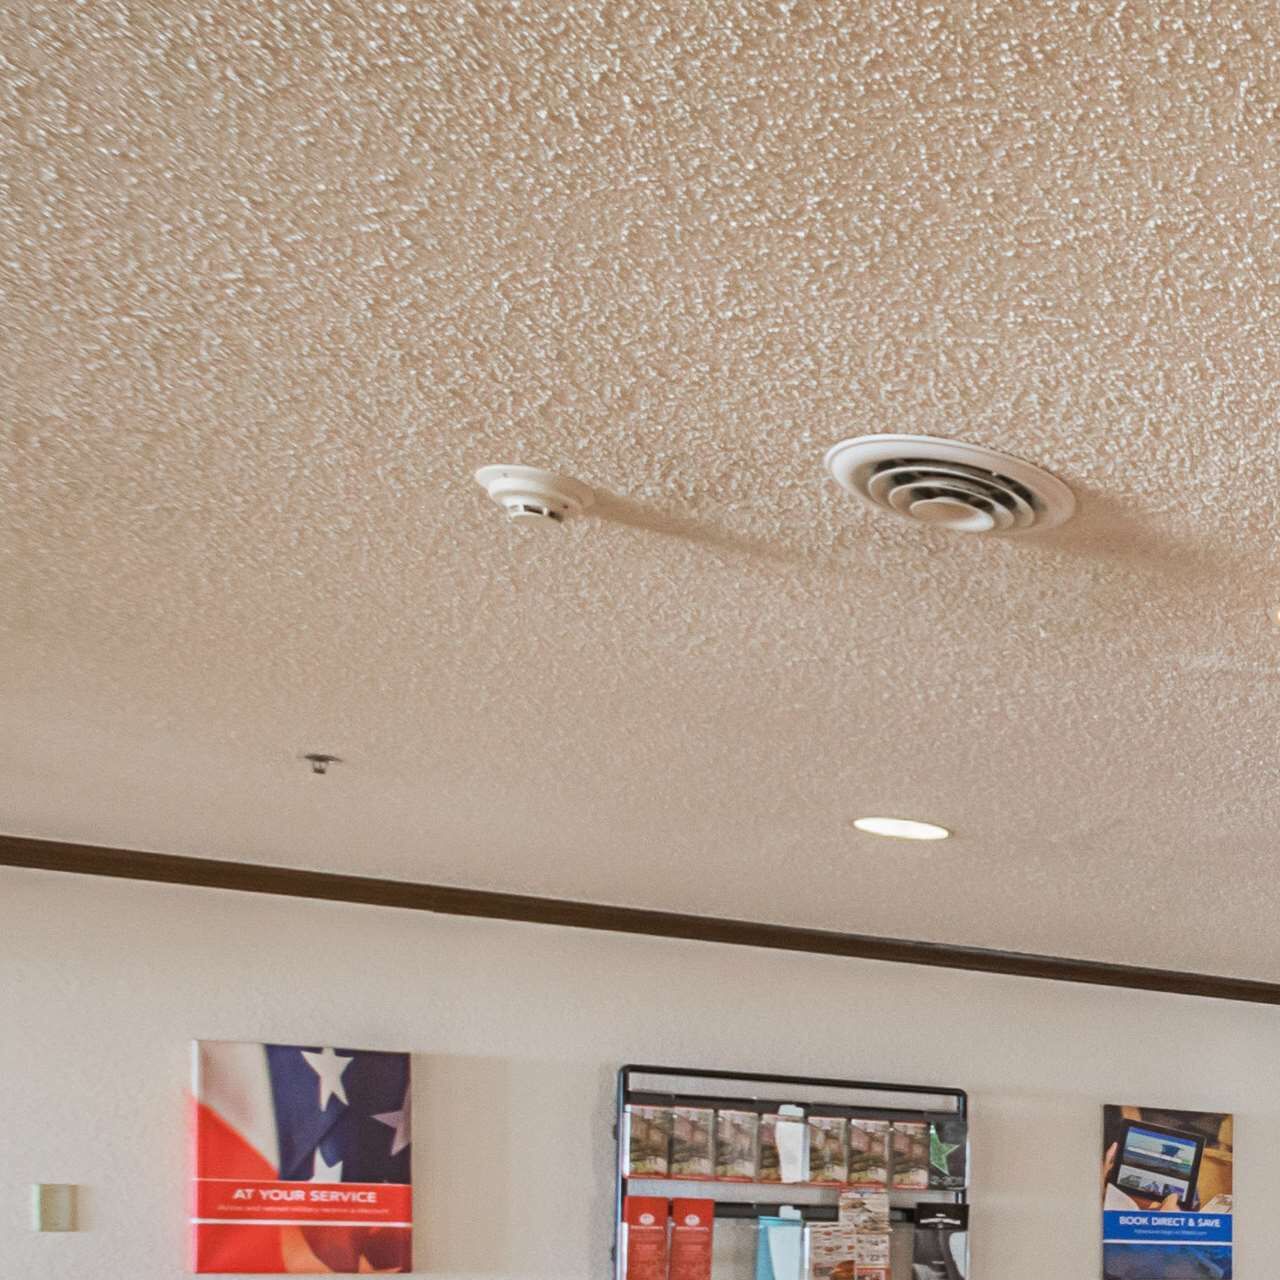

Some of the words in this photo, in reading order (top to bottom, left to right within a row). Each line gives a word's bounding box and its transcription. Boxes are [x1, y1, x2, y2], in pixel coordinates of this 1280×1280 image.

[233, 1188, 254, 1200] AT
[259, 1189, 305, 1201] YOUR
[309, 1190, 377, 1203] SERVICE
[1119, 1216, 1149, 1225] BOOK
[1151, 1217, 1185, 1227] DIRECT
[1187, 1218, 1195, 1227] &
[1198, 1218, 1221, 1228] SAVE
